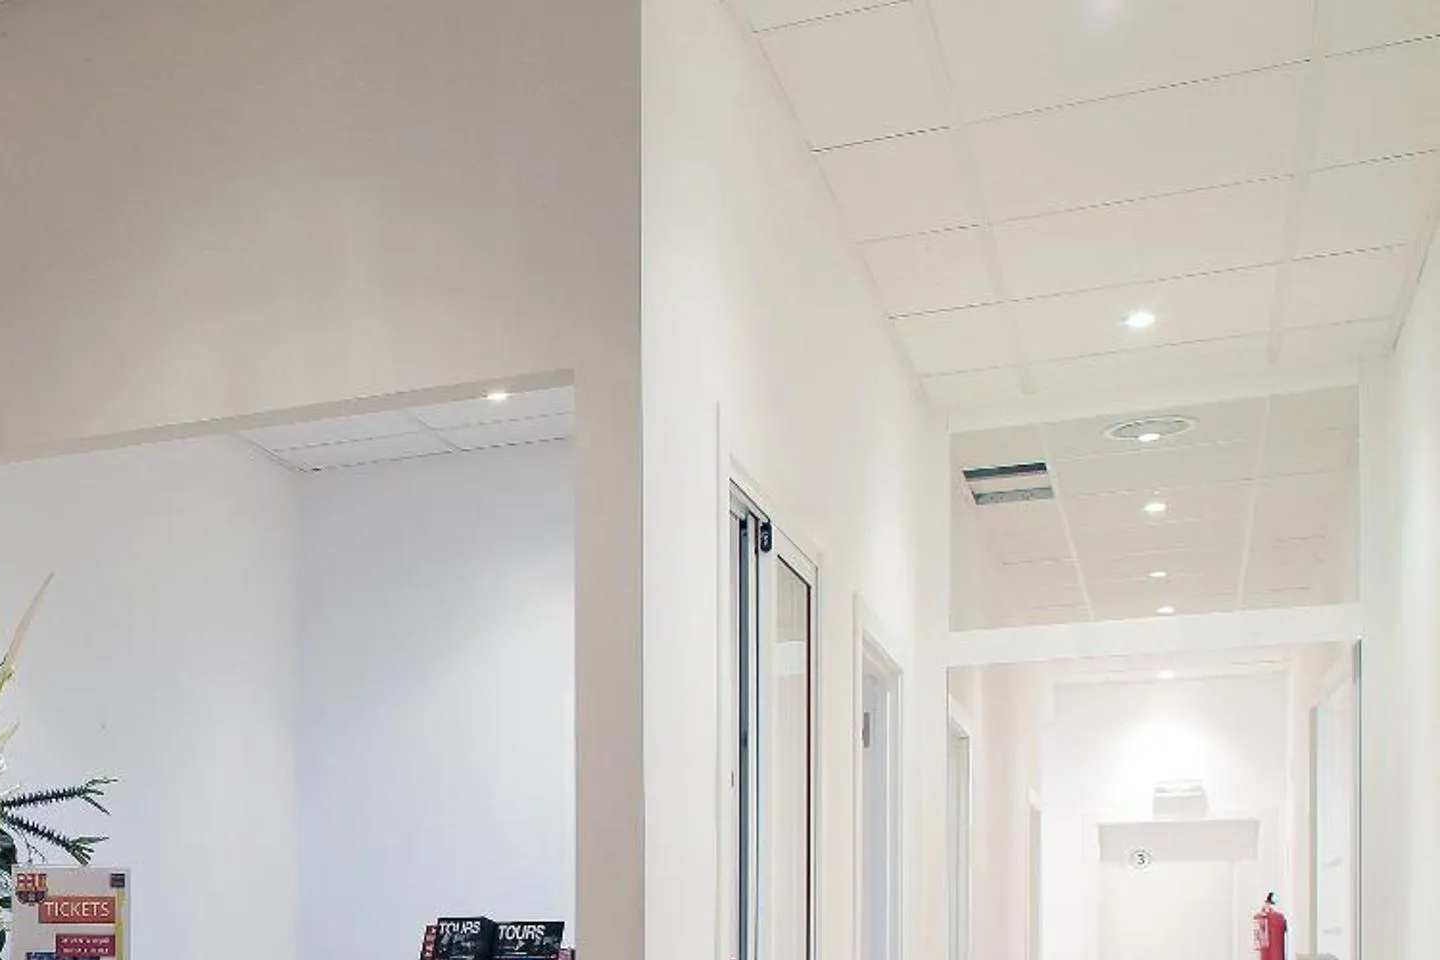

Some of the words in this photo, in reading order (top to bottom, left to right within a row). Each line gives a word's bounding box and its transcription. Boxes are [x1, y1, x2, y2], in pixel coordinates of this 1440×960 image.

[1137, 853, 1146, 865] 3
[43, 901, 111, 917] TICKETS
[439, 921, 481, 935] TOURS
[498, 924, 546, 940] TOURS
